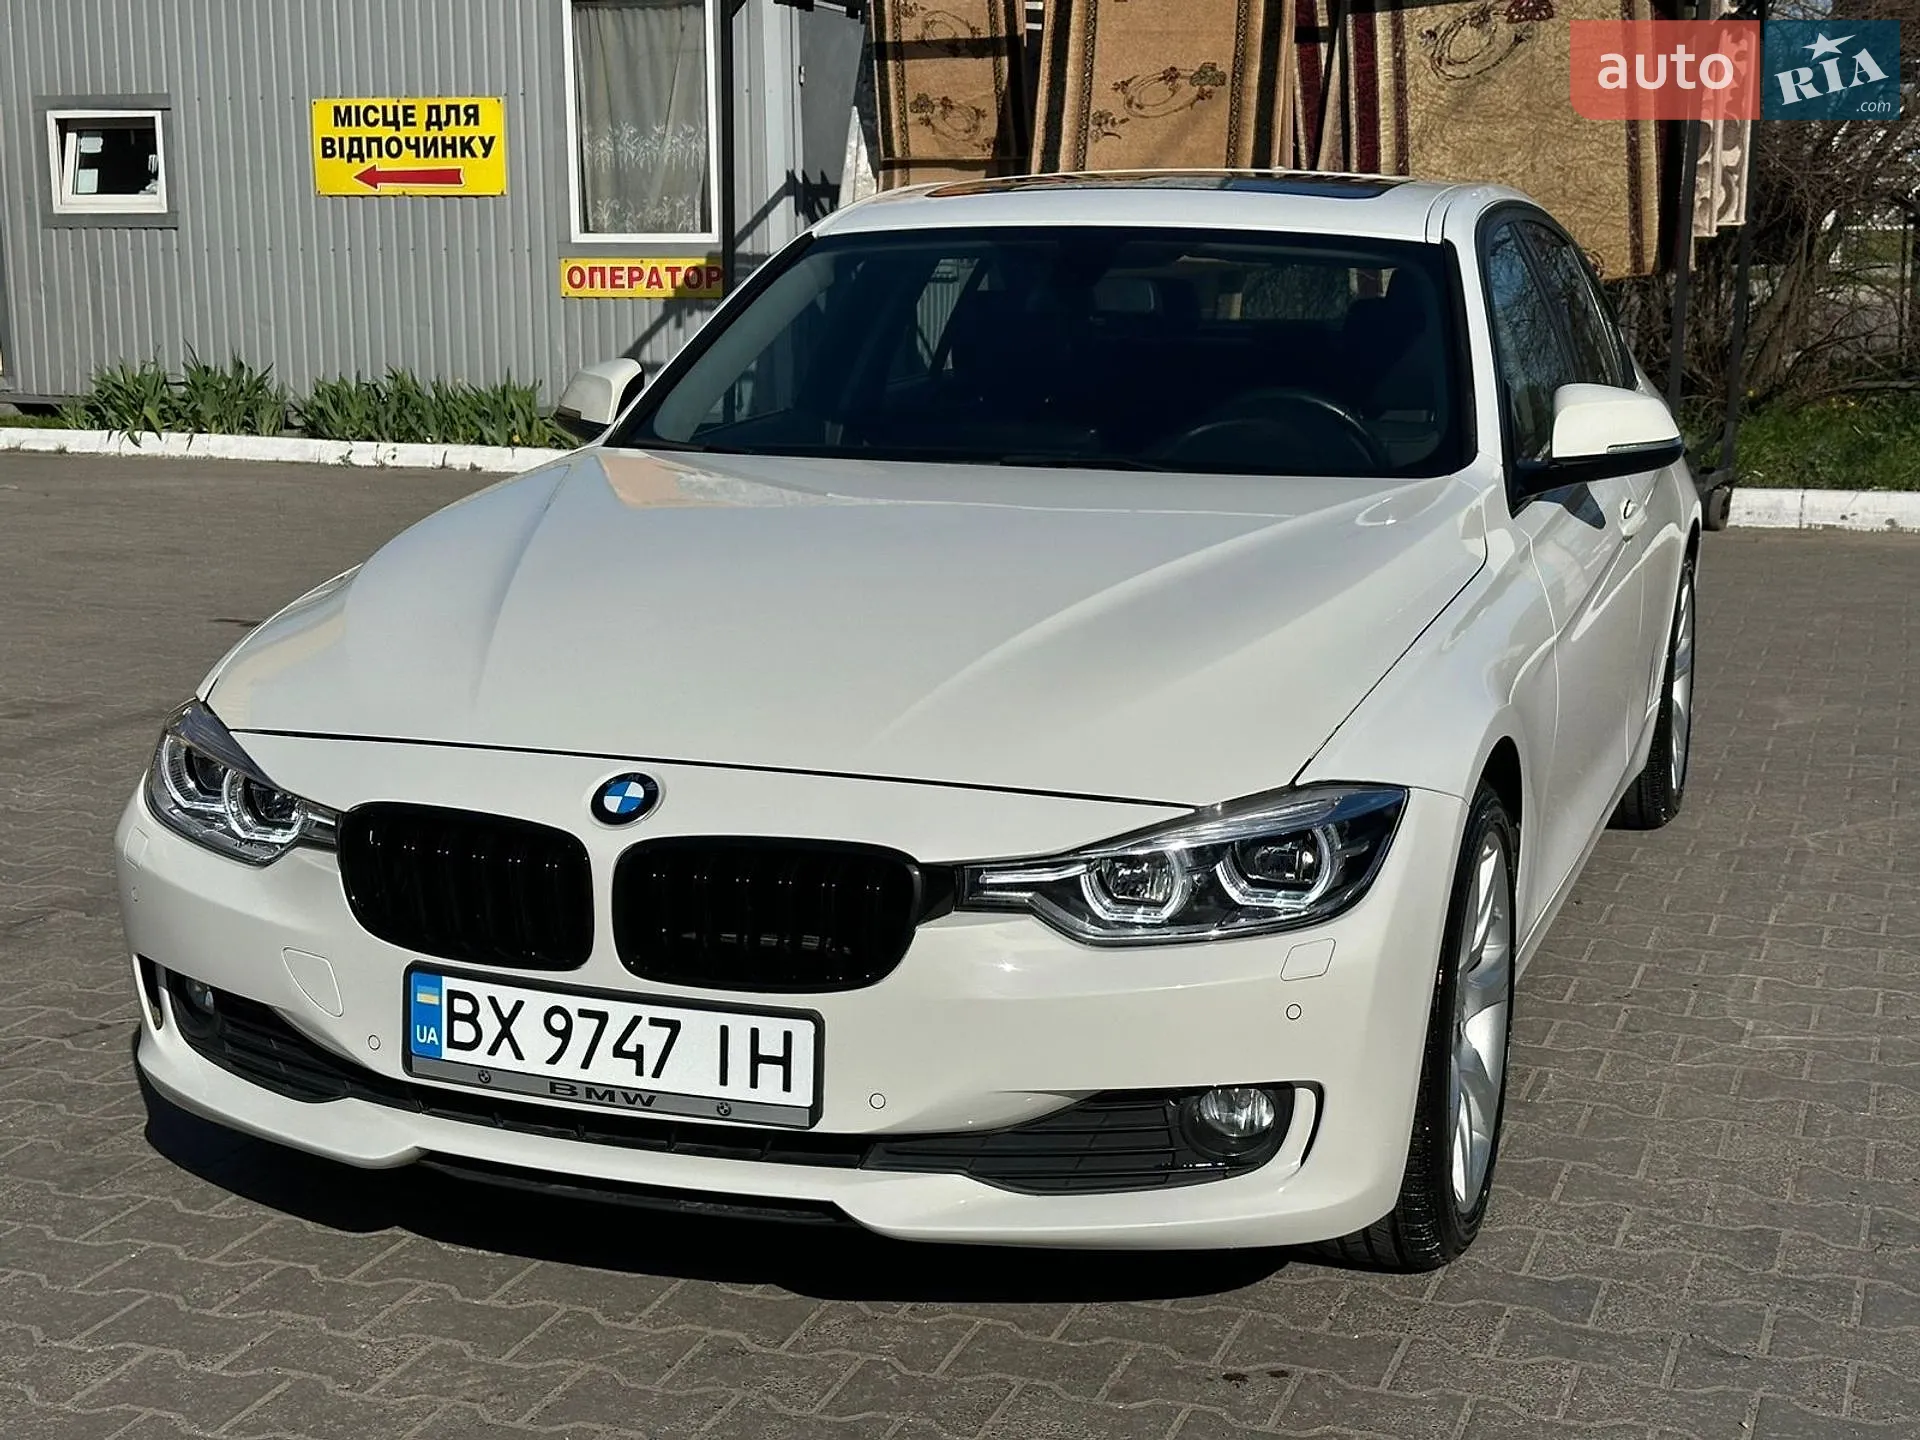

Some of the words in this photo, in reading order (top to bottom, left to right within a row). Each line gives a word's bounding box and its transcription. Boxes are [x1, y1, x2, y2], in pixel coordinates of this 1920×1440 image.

[333, 104, 417, 131] МІСЦЕ
[425, 104, 480, 131] ДЛЯ
[321, 135, 495, 163] ВІДПОЧИНКУ
[567, 266, 721, 289] ОПЕРАТОР
[416, 1025, 439, 1046] UA
[446, 989, 525, 1061] BX
[543, 1004, 682, 1078] 9747
[719, 1024, 793, 1092] IH
[549, 1081, 657, 1107] BMW
